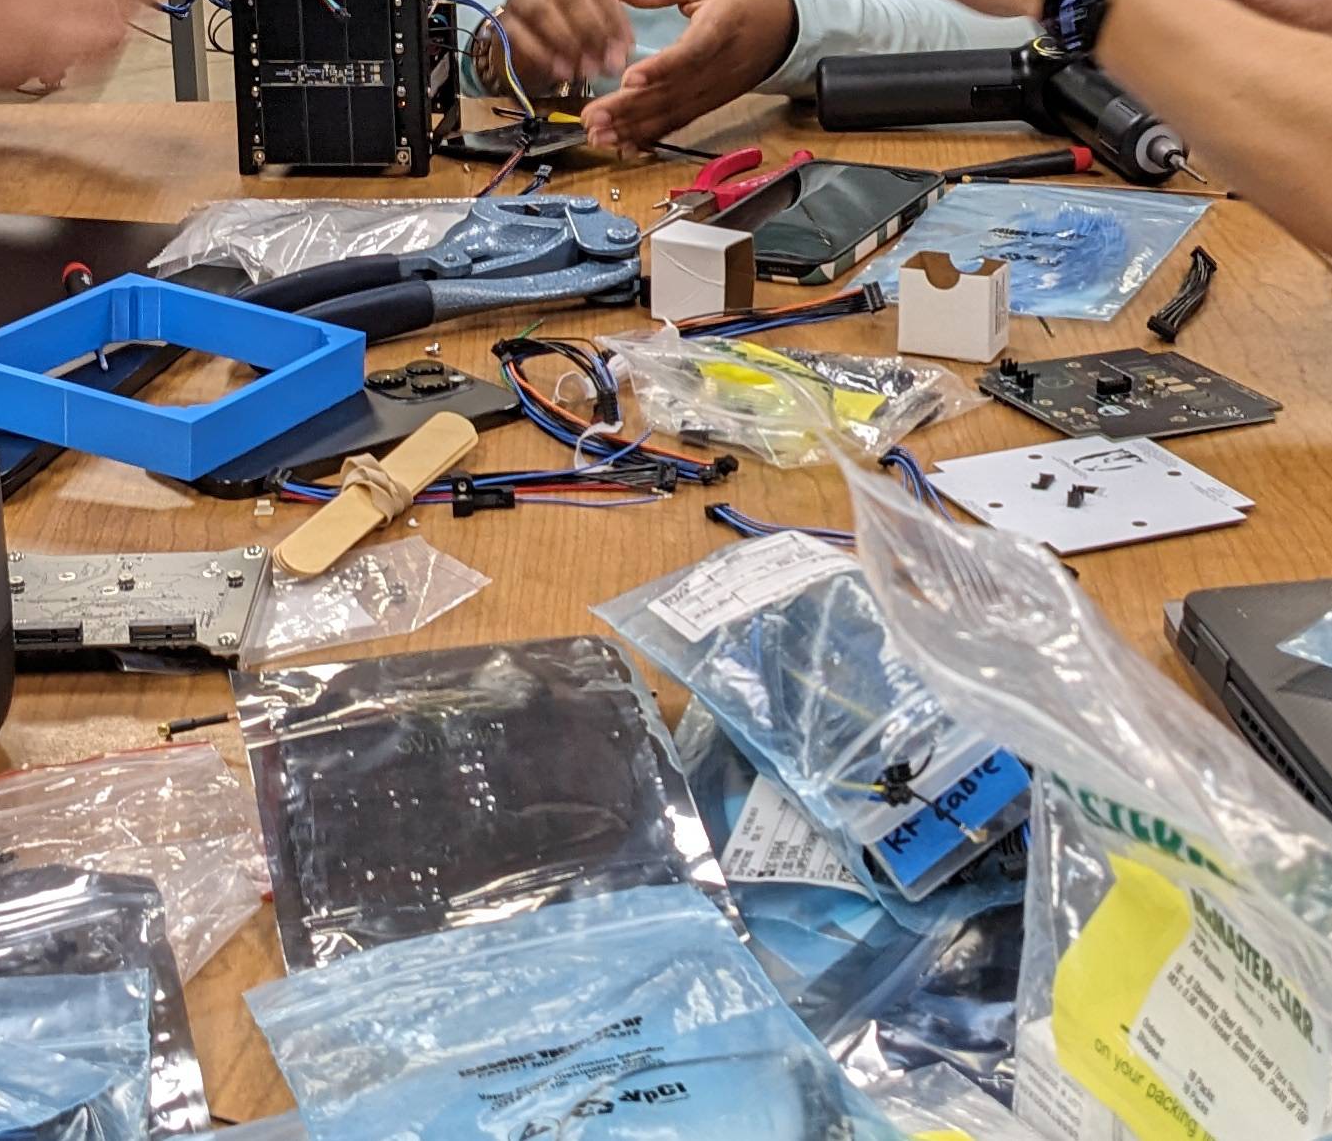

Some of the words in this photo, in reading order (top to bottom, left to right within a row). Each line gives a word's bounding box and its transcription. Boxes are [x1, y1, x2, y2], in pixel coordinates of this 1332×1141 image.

[1094, 1038, 1111, 1059] on
[1113, 1054, 1145, 1086] your
[1145, 1082, 1199, 1138] packing
